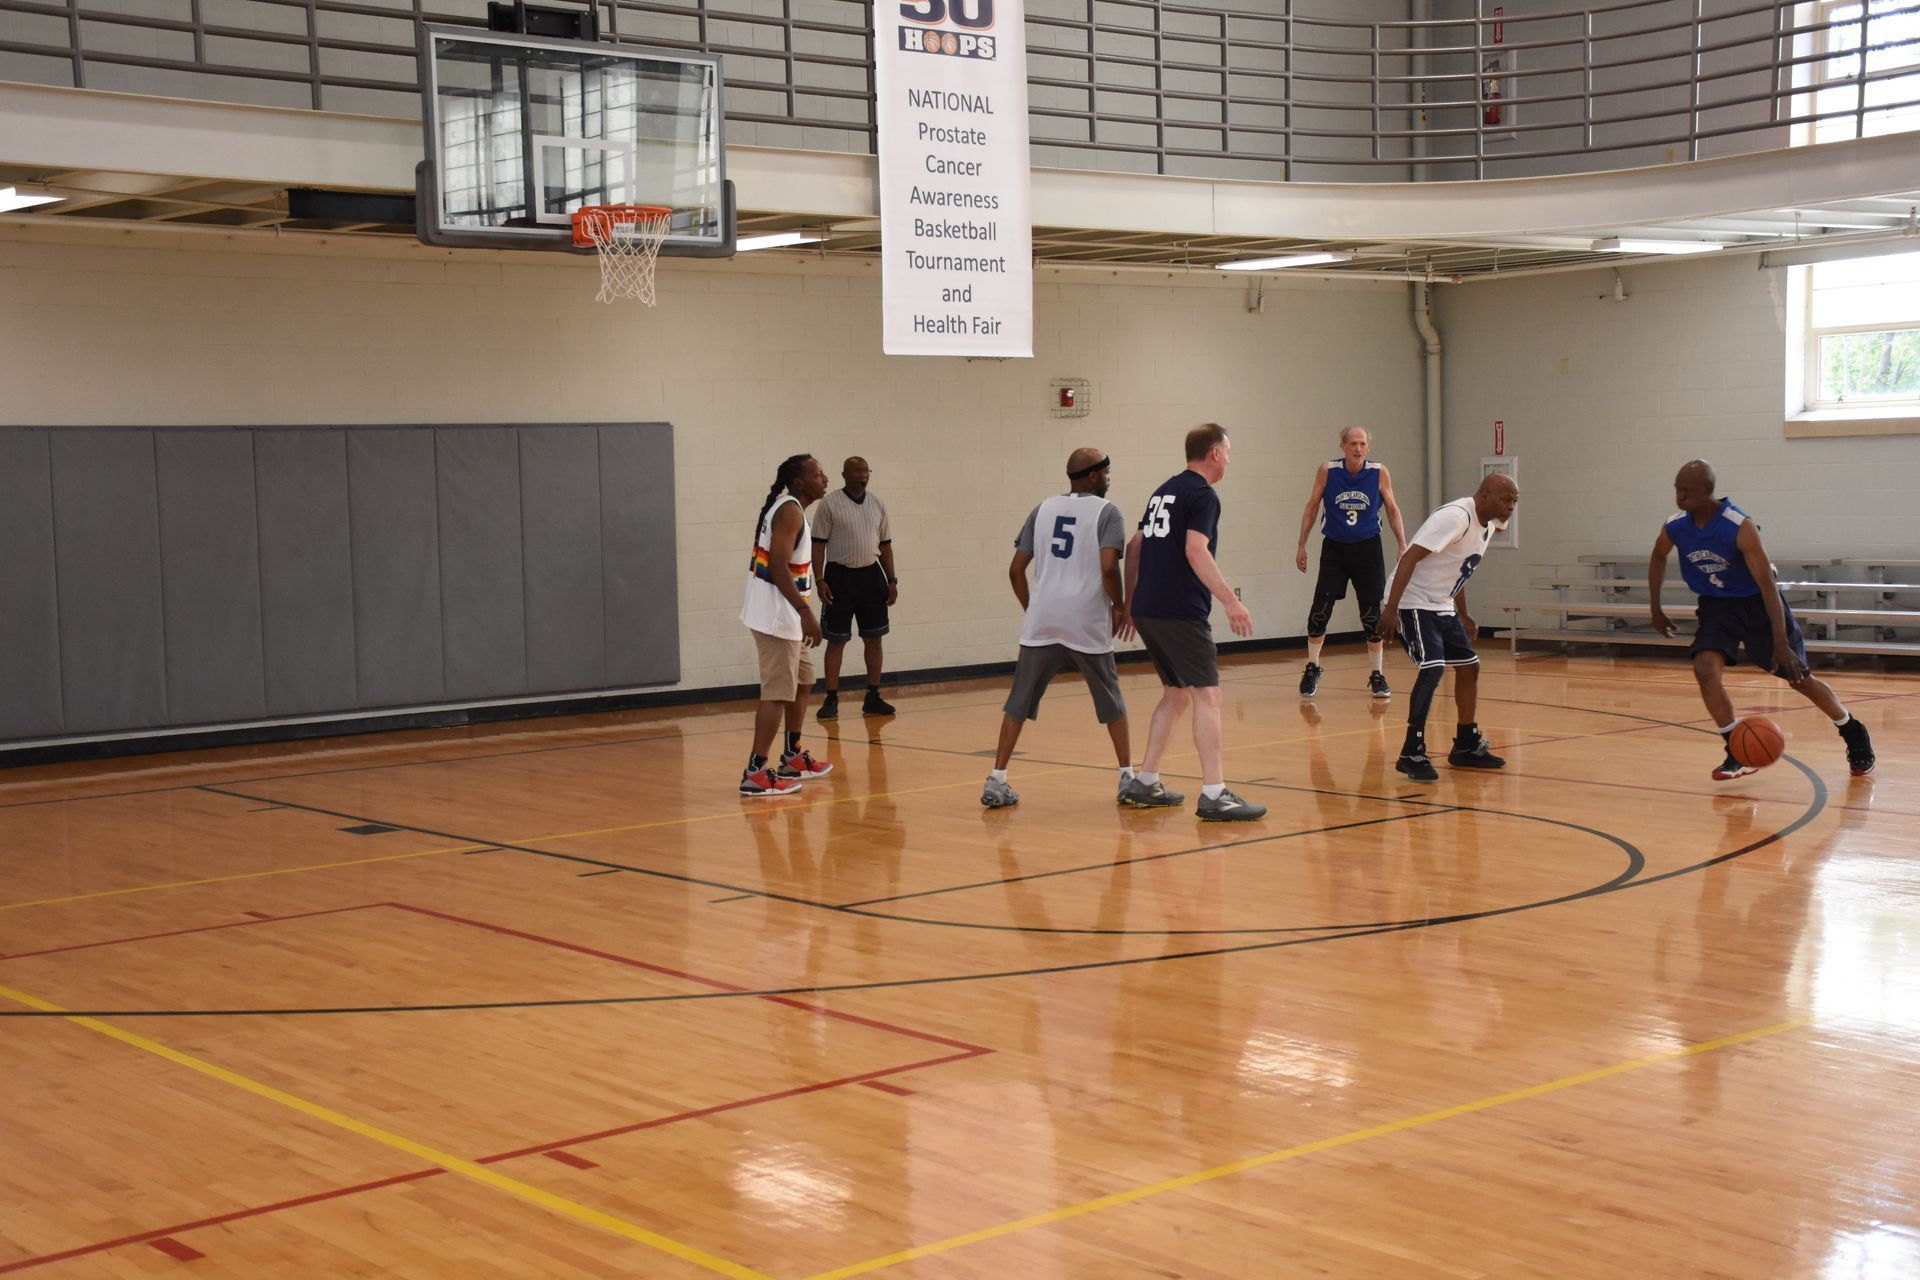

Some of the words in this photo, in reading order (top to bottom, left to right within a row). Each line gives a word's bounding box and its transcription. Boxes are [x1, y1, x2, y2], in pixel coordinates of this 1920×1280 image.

[904, 28, 994, 58] HOOPS
[908, 88, 994, 115] NATIONAL
[918, 121, 986, 146] Prostate
[925, 154, 982, 176] Cancer
[910, 185, 999, 210] Awareness
[914, 218, 997, 241] Basketball
[905, 250, 1006, 273] Tournament
[942, 283, 972, 303] and
[914, 314, 967, 334] Health
[973, 316, 1002, 335] Fair
[1143, 495, 1176, 538] 35
[1346, 510, 1358, 525] 3
[1051, 515, 1077, 559] 5
